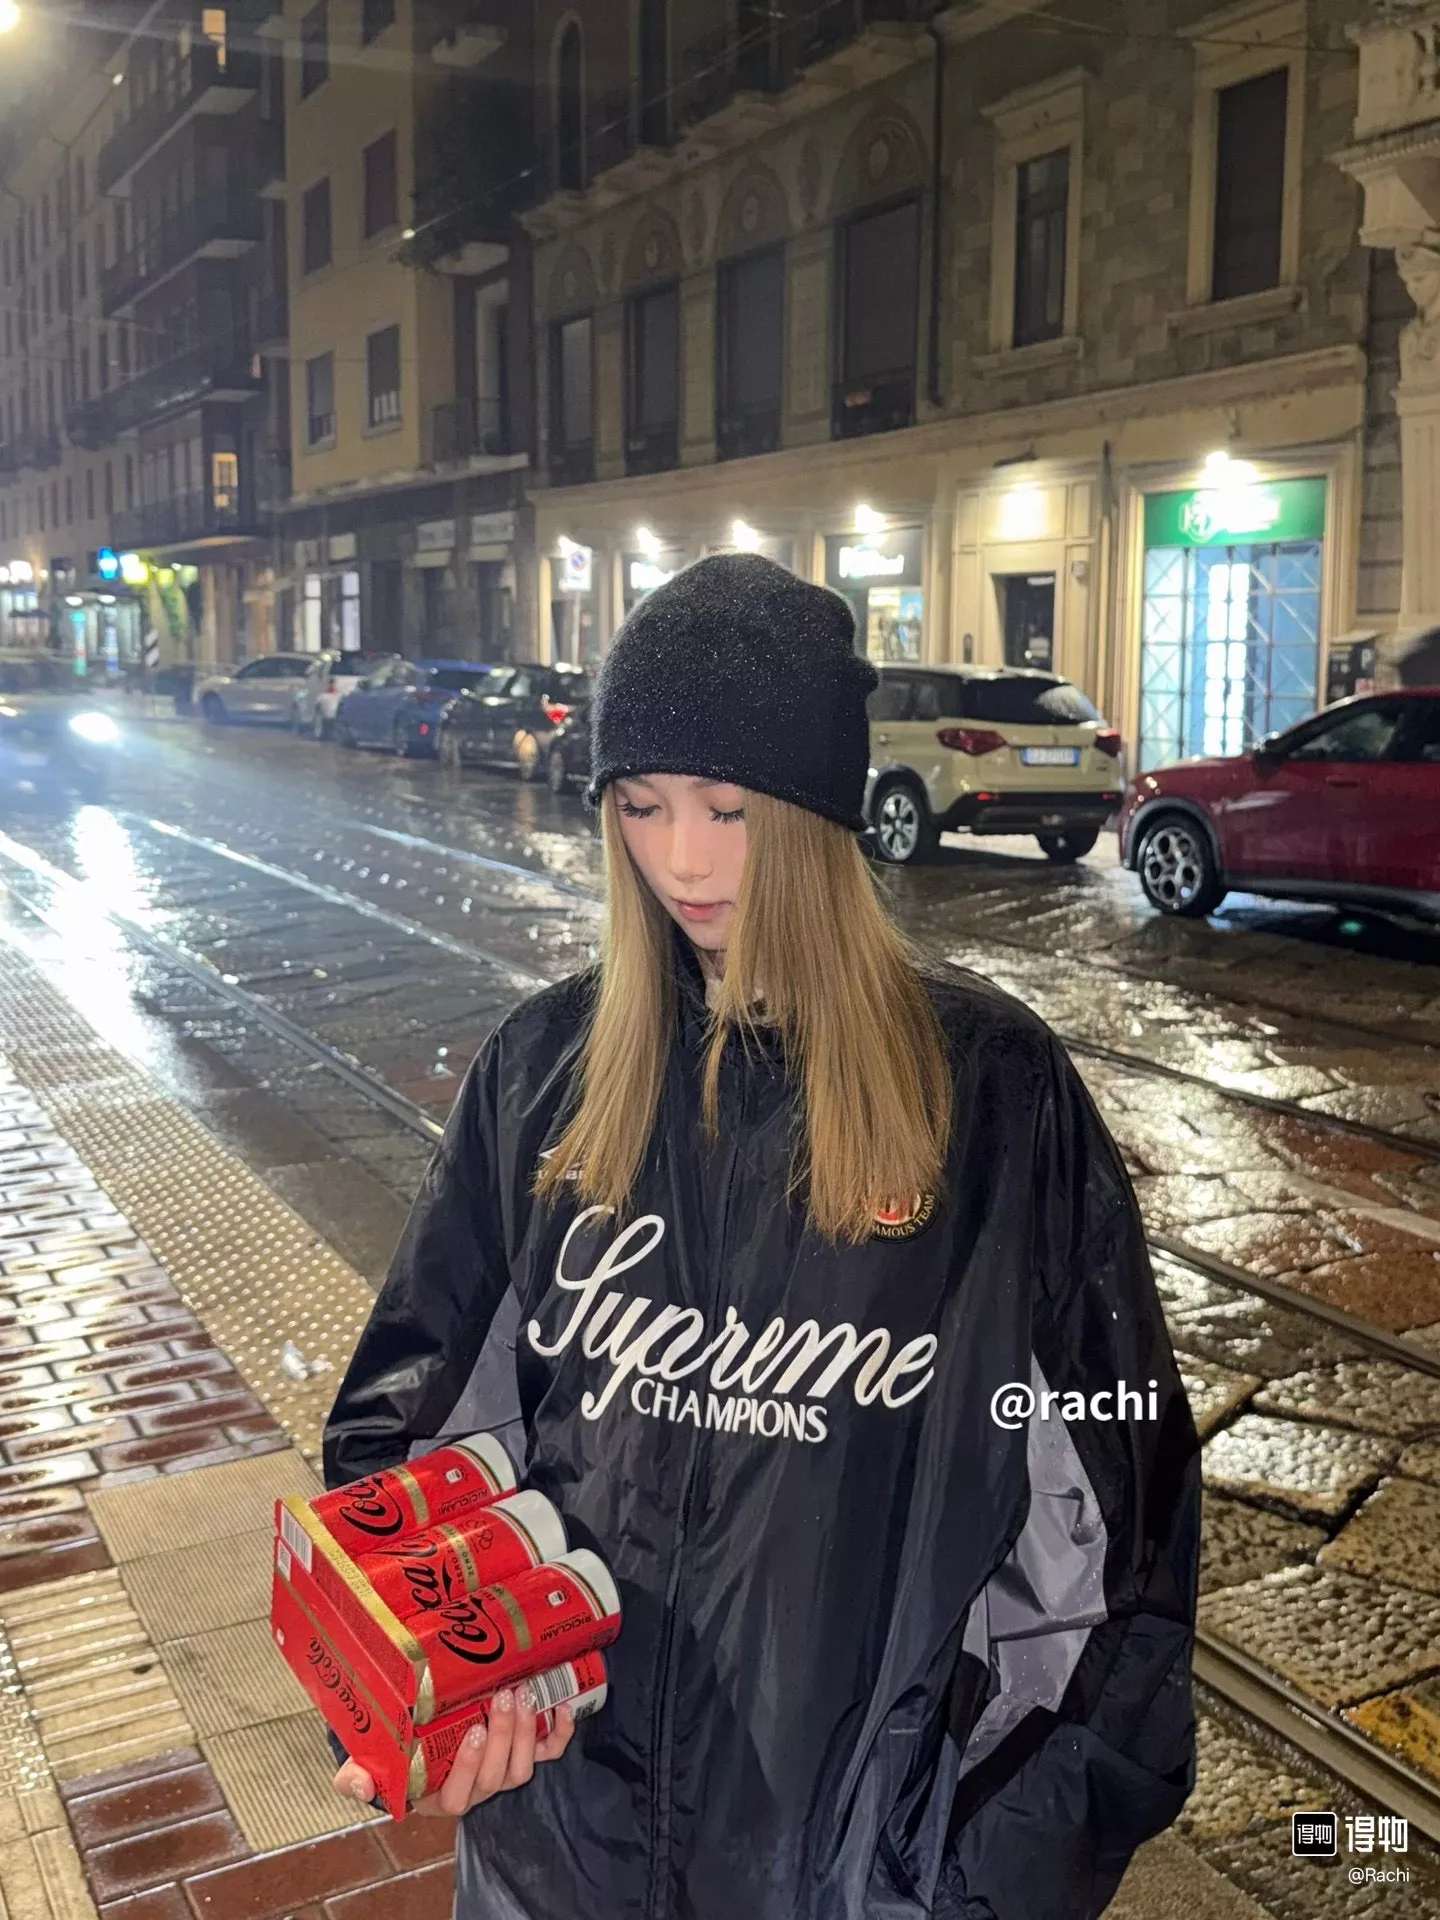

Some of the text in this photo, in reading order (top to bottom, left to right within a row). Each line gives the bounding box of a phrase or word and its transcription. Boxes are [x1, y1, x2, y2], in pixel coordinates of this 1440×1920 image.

[914, 1194, 935, 1227] TEAM
[527, 1204, 938, 1421] Supreme
[631, 1377, 829, 1443] CHAMPIONS
[436, 1489, 489, 1516] RICICLAMI
[539, 1614, 592, 1642] RICICLAMI
